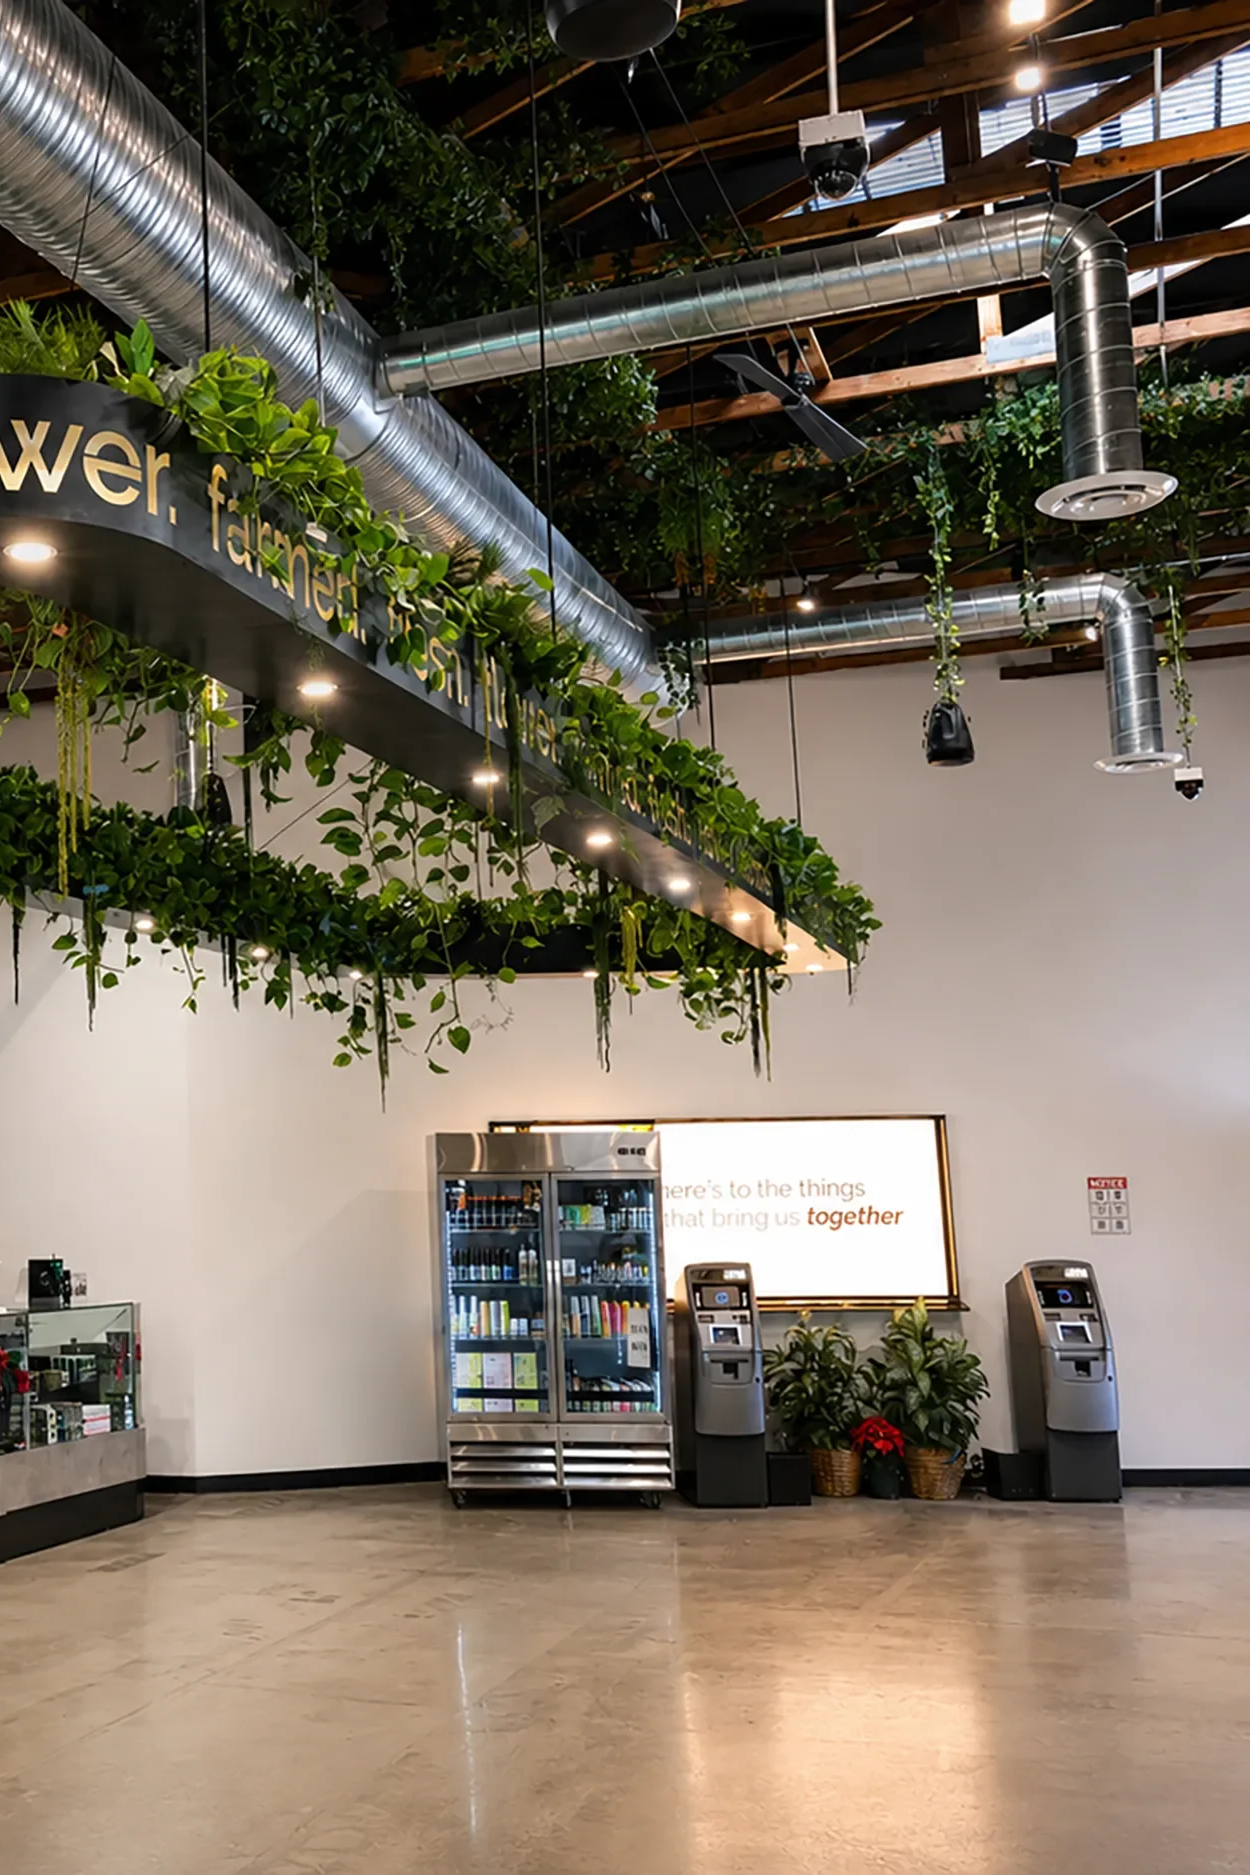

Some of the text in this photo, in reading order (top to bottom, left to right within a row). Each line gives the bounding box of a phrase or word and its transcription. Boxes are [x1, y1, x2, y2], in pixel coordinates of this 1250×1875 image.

[729, 1179, 751, 1199] to
[757, 1179, 793, 1198] the
[799, 1178, 866, 1202] things
[712, 1209, 768, 1232] bring
[774, 1211, 801, 1227] us
[807, 1206, 904, 1231] together
